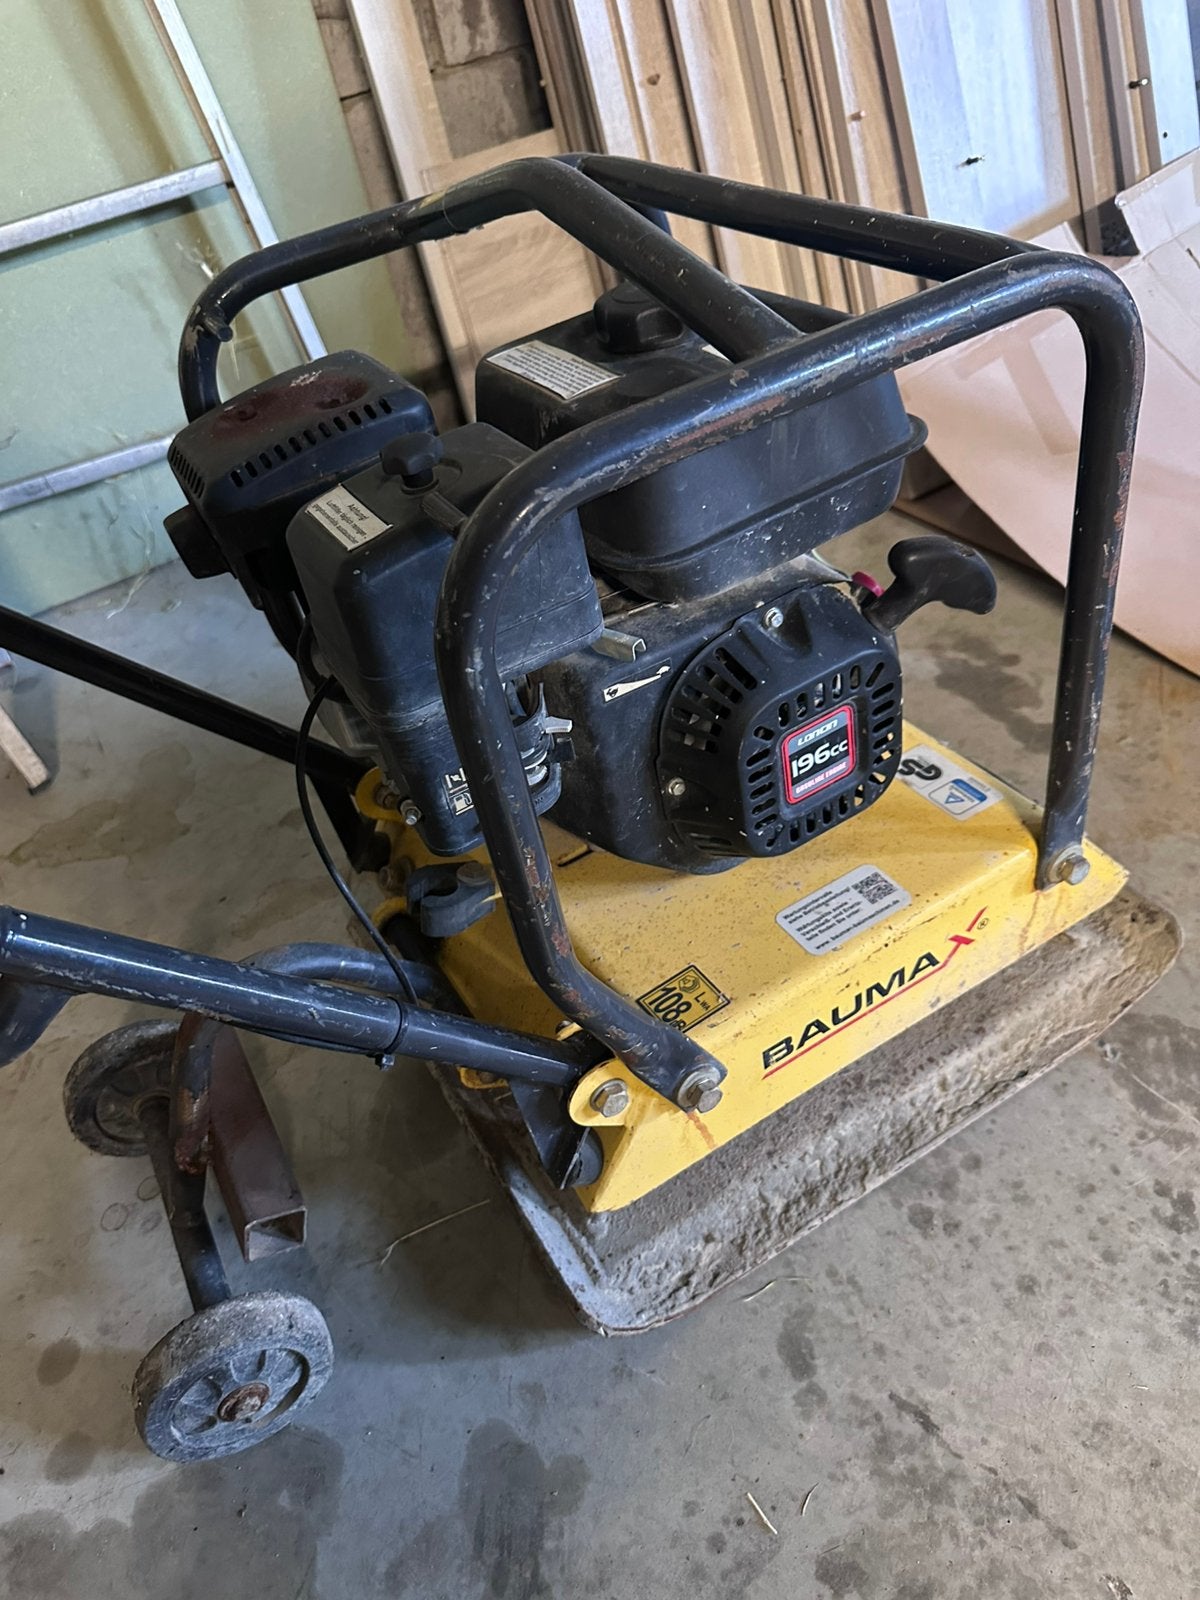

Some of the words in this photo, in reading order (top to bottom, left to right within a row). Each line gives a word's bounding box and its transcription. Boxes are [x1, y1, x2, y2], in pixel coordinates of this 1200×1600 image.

[791, 739, 848, 778] 196cc
[648, 986, 692, 1022] 108
[762, 906, 988, 1071] BAUMAX
